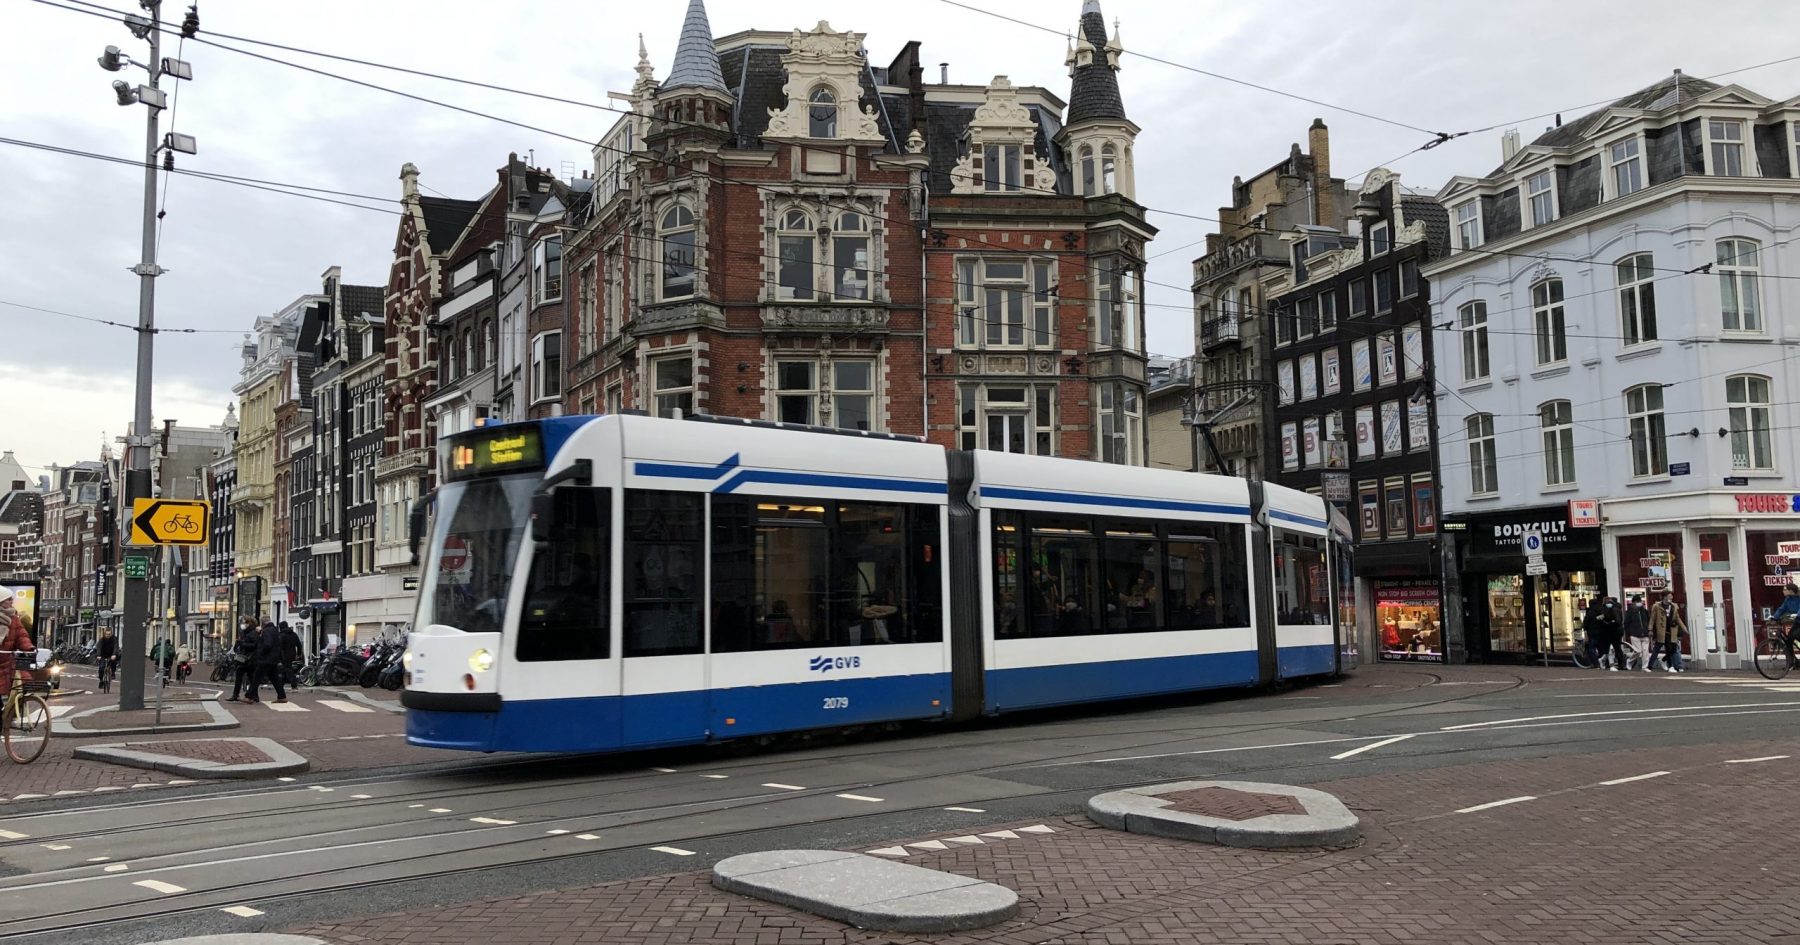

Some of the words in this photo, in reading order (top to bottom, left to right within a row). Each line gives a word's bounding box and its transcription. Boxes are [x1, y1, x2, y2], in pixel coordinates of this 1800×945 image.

[1735, 494, 1789, 513] TOURS
[1494, 520, 1566, 537] BODYCULT
[1495, 538, 1521, 546] TATTOO
[1544, 535, 1567, 543] RCING
[1640, 558, 1661, 568] TOURS
[1766, 555, 1789, 565] TOURS
[1639, 577, 1666, 587] TICKETS
[1763, 576, 1793, 586] TICKETS
[835, 656, 861, 669] GVB
[823, 697, 849, 709] 2079
